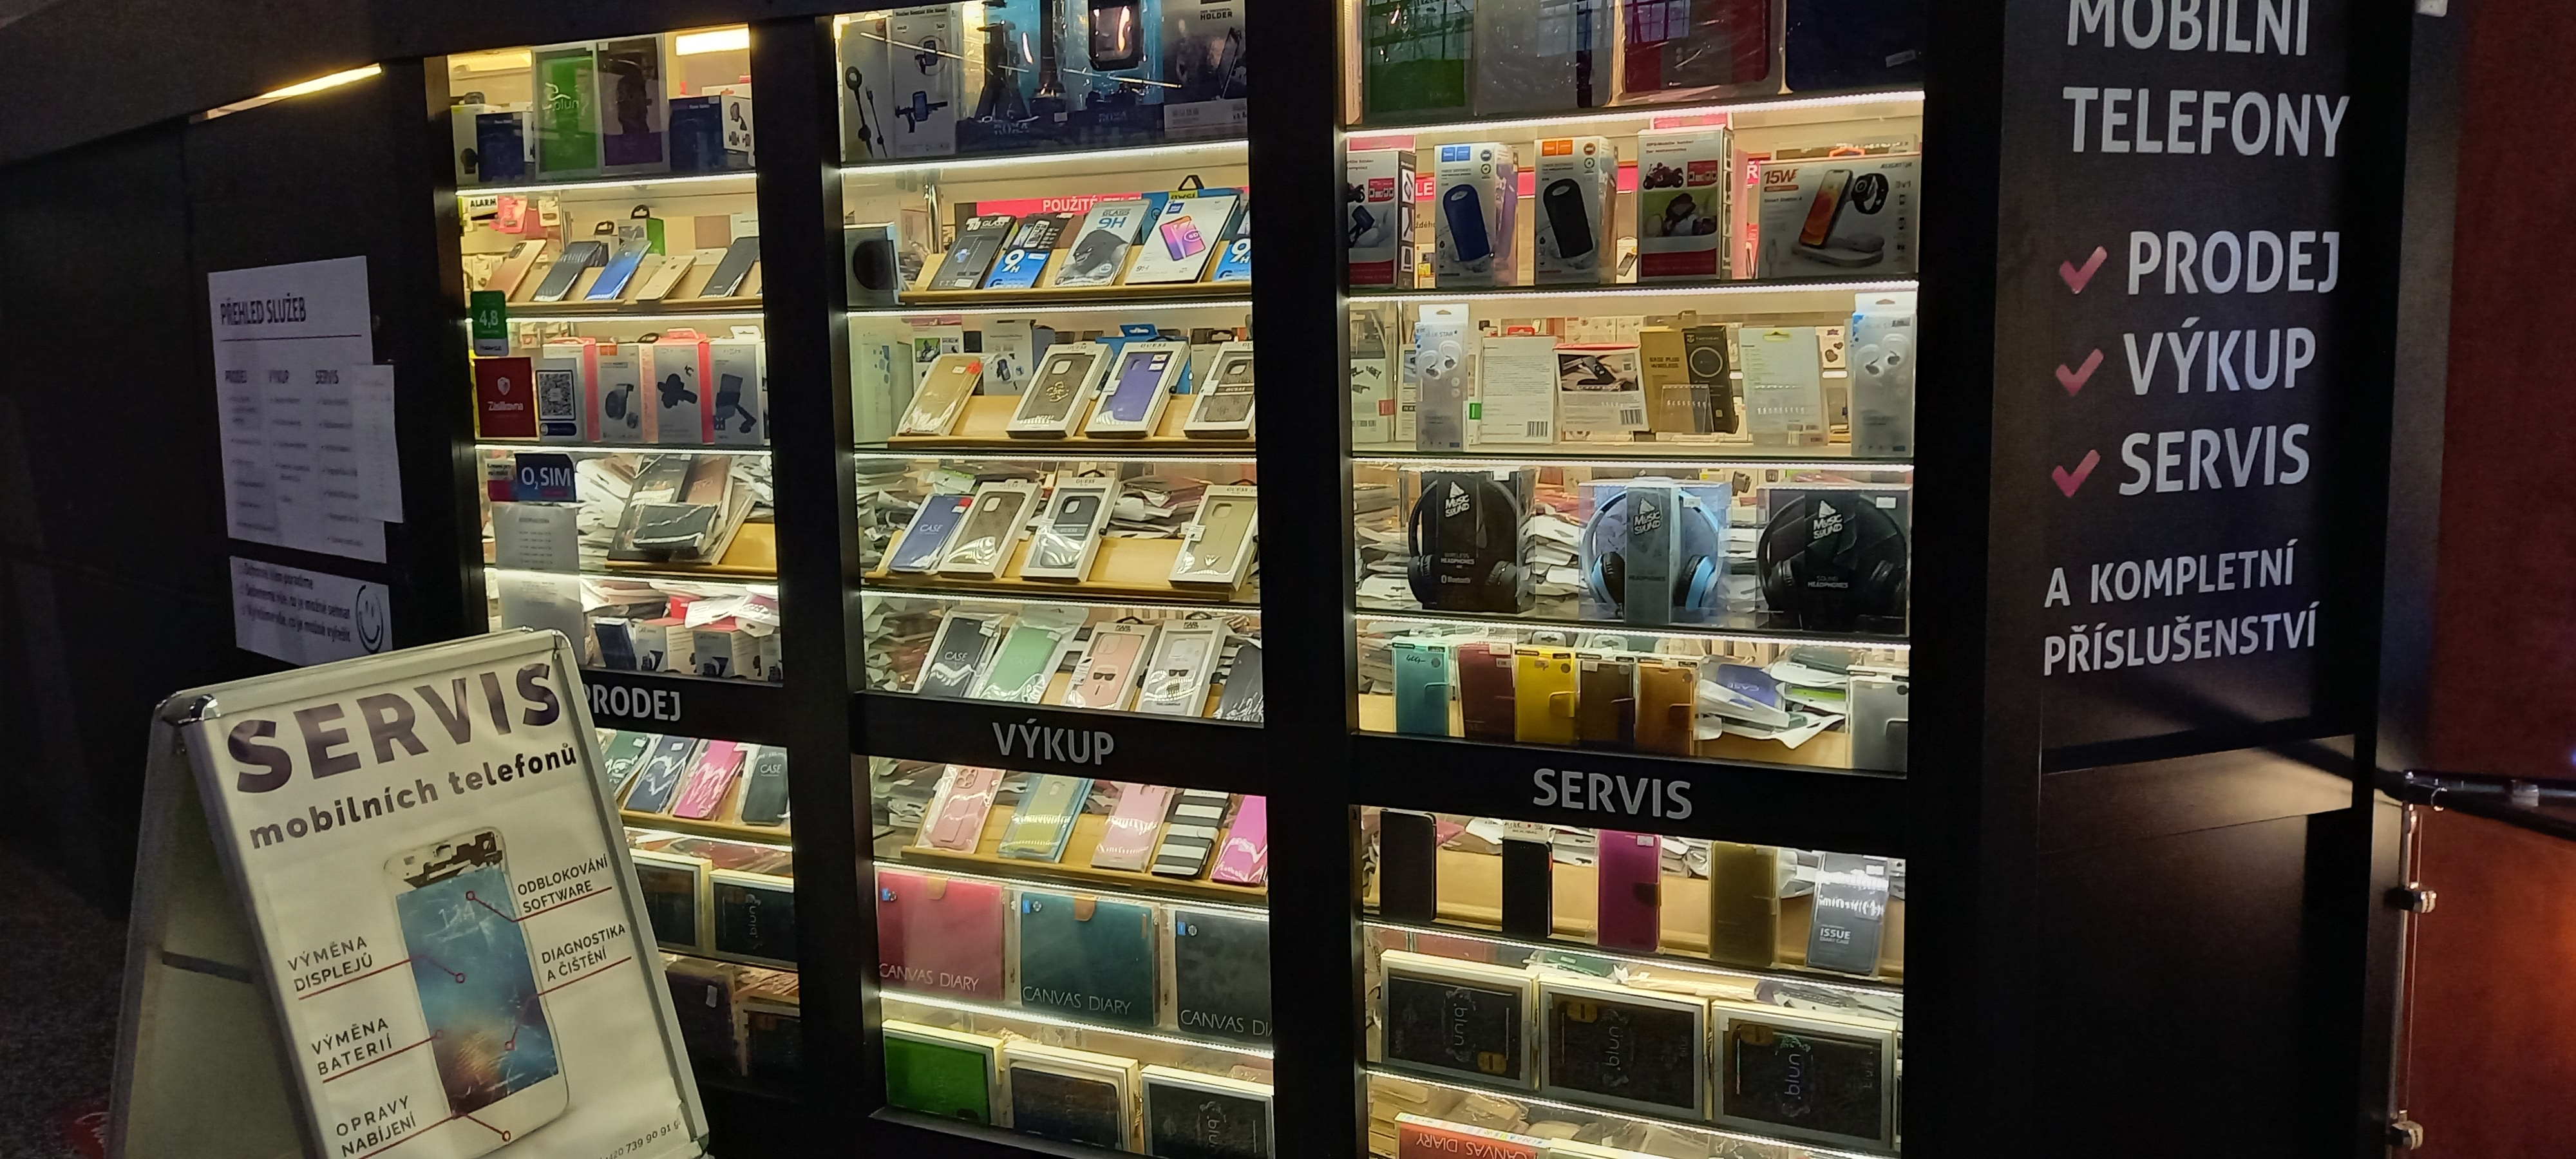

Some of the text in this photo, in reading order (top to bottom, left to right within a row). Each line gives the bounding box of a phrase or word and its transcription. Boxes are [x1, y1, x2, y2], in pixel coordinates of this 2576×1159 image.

[1200, 12, 1233, 21] HOLDER
[2063, 87, 2351, 156] TELEFONY
[470, 198, 497, 207] ALARM
[1096, 217, 1127, 229] 9H
[1001, 249, 1025, 273] 9H
[2128, 230, 2340, 296] PRODEJ
[220, 292, 307, 325] PŘEHLED SLUŽEB
[2123, 316, 2316, 396] VÝKUP
[2119, 423, 2310, 496] SERVIS
[540, 467, 571, 487] SIM
[1444, 503, 1470, 518] SOUND
[919, 524, 943, 533] CASE
[1634, 520, 1662, 536] SOUND
[1813, 523, 1843, 540] SOUND
[2044, 538, 2298, 608] A KOMPLETNÍ
[944, 651, 968, 661] CASE
[2043, 601, 2320, 677] PŘÍSLUŠENSTVÍ
[227, 663, 560, 794] SERVIS
[992, 717, 1115, 765] VÝKUP
[760, 764, 782, 774] CASE
[250, 742, 577, 849] mobilních telefonů
[1532, 768, 1693, 820] SERVIS
[517, 856, 609, 896] ODBLOKOVÁNÍ
[522, 880, 594, 914] SOFTWARE
[541, 923, 626, 965] DIAGNOSTIKA
[1820, 927, 1852, 939] ISSUE
[288, 936, 368, 971] VÝMĚNA
[546, 945, 609, 982] A ČIŠTĚNÍ
[293, 953, 374, 993] DISPLEJŮ
[878, 963, 980, 992] CANVAS DIARY
[1022, 986, 1132, 1015] CANVAS DIARY
[310, 1017, 389, 1056] VÝMĚNA
[1180, 1010, 1245, 1033] CANVAS
[317, 1037, 393, 1076] BATERIÍ
[336, 1095, 410, 1136] OPRAVY
[341, 1110, 417, 1158] NABÍJENÍ
[626, 1138, 643, 1154] 739
[646, 1130, 658, 1144] 90
[660, 1124, 671, 1136] 91
[1416, 1132, 1458, 1153] DIARY
